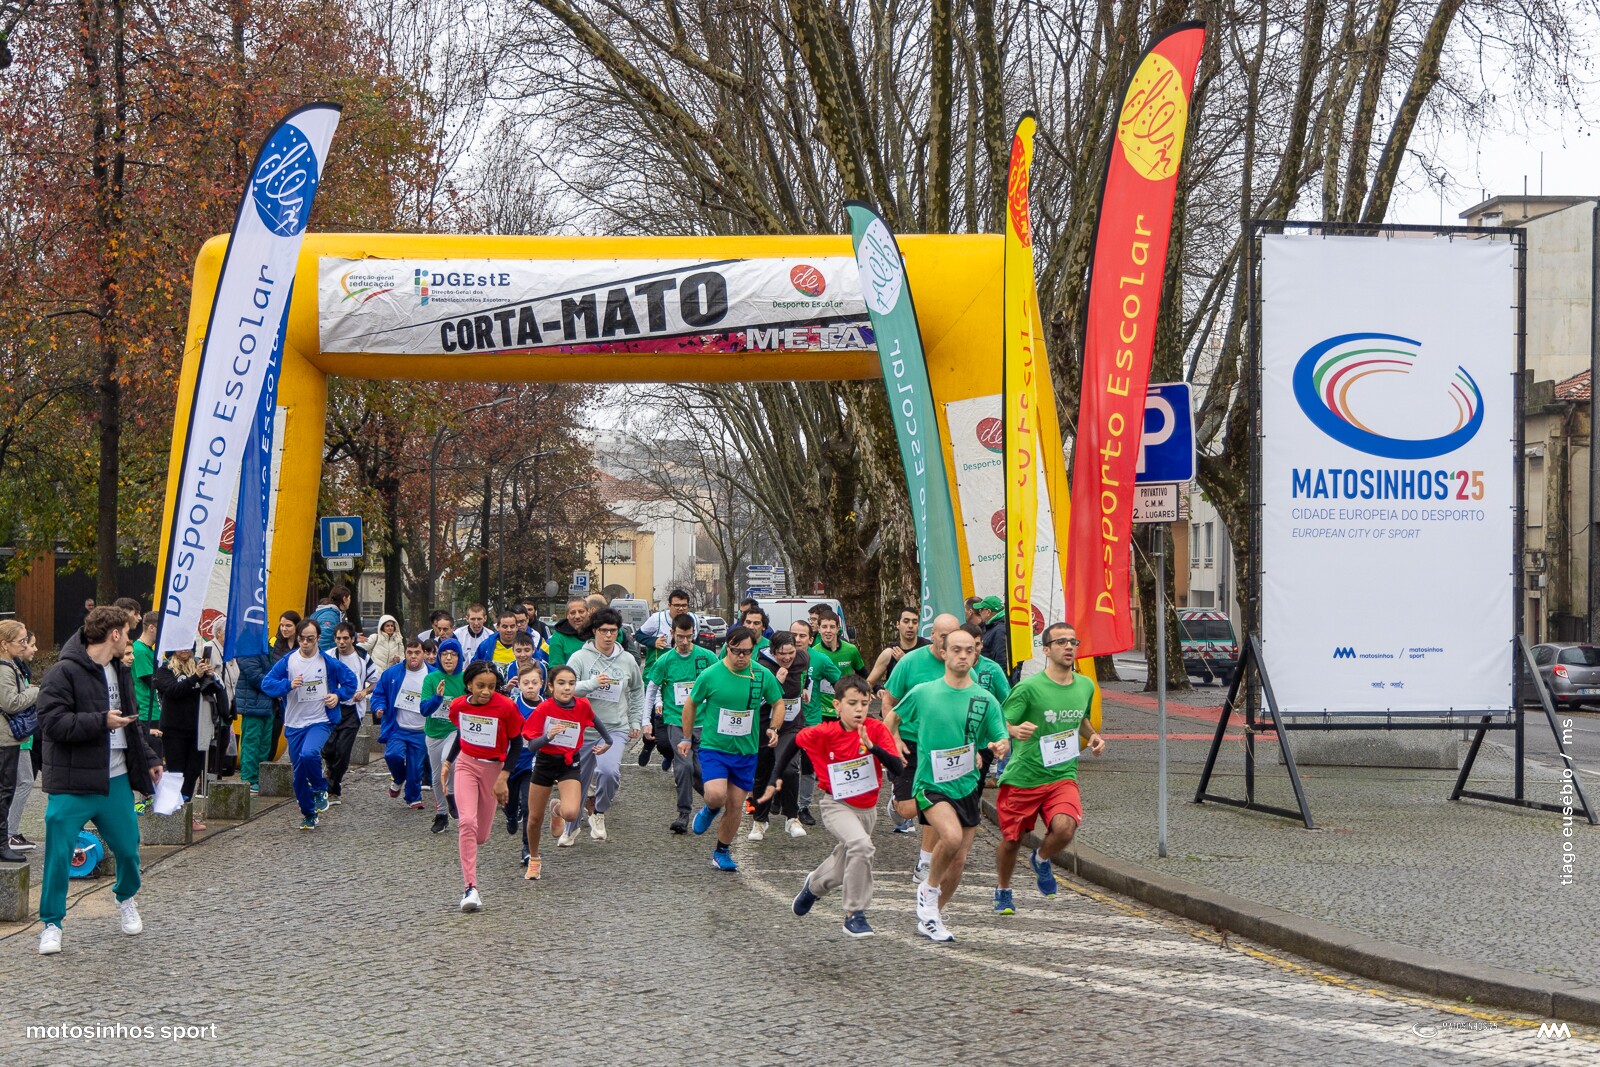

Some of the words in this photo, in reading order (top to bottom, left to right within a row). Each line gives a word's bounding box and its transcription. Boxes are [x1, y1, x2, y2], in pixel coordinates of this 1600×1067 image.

[431, 273, 511, 287] DGEstE
[772, 301, 810, 309] Desporto
[811, 301, 844, 309] Escolar
[1106, 213, 1153, 397] Escolar
[440, 271, 728, 353] CORTA-MATO
[745, 327, 869, 350] META
[164, 436, 227, 618] Desporto
[213, 264, 275, 422] Escolar
[1136, 396, 1175, 474] P
[962, 459, 1002, 472] Desporto
[1140, 487, 1168, 497] PRIVATIVO
[1094, 412, 1126, 617] Desporto
[1145, 511, 1175, 519] LUGARES
[1291, 508, 1336, 521] CIDADE
[1339, 508, 1399, 521] EUROPEIA
[1401, 509, 1419, 521] DO
[1421, 509, 1485, 522] DESPORTO
[330, 522, 354, 553] P
[1291, 527, 1346, 539] EUROPEAN
[1347, 528, 1371, 539] CITY
[1372, 528, 1388, 539] OF
[1387, 528, 1421, 539] SPORT
[978, 552, 1005, 563] Despor
[405, 694, 415, 702] 42
[730, 716, 742, 725] 38
[1058, 709, 1083, 721] JOGOS
[469, 722, 482, 732] 28
[1054, 739, 1067, 750] 49
[946, 755, 961, 767] 37
[843, 768, 860, 781] 35
